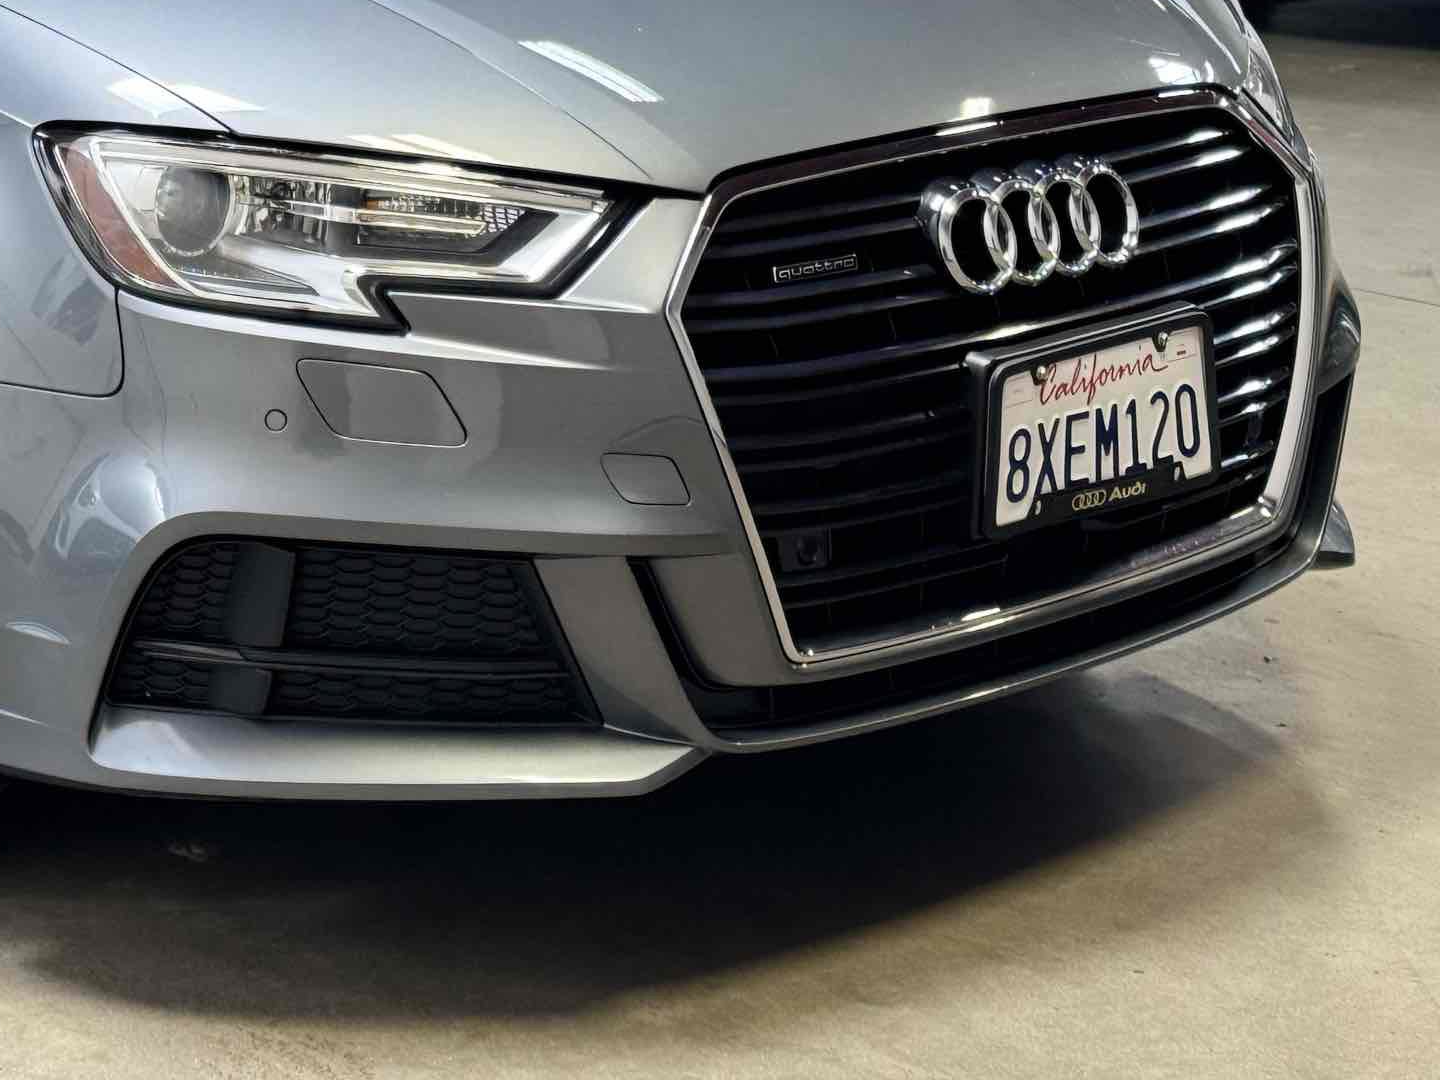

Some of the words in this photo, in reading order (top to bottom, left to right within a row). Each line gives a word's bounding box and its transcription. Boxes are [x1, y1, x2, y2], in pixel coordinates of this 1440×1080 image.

[778, 258, 855, 280] quattro
[1037, 344, 1168, 406] California
[1006, 383, 1201, 503] 8XEM120
[1109, 482, 1147, 502] Audi
